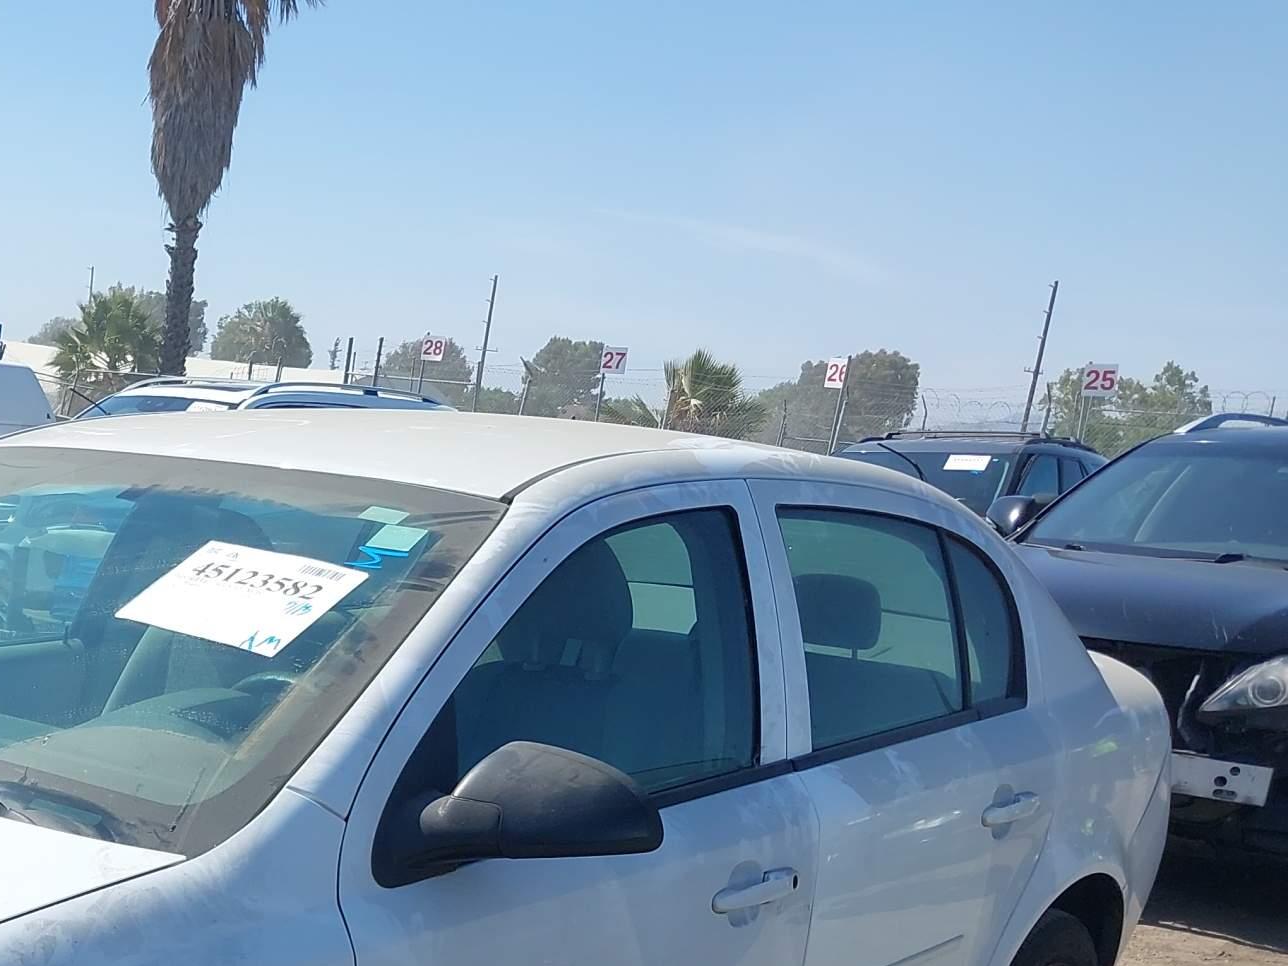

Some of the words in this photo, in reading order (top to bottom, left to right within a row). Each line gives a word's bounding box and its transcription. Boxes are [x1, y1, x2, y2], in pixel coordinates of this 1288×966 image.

[423, 339, 443, 356] 28
[602, 351, 627, 370] 27
[1083, 369, 1116, 391] 25
[192, 562, 323, 600] 45123582
